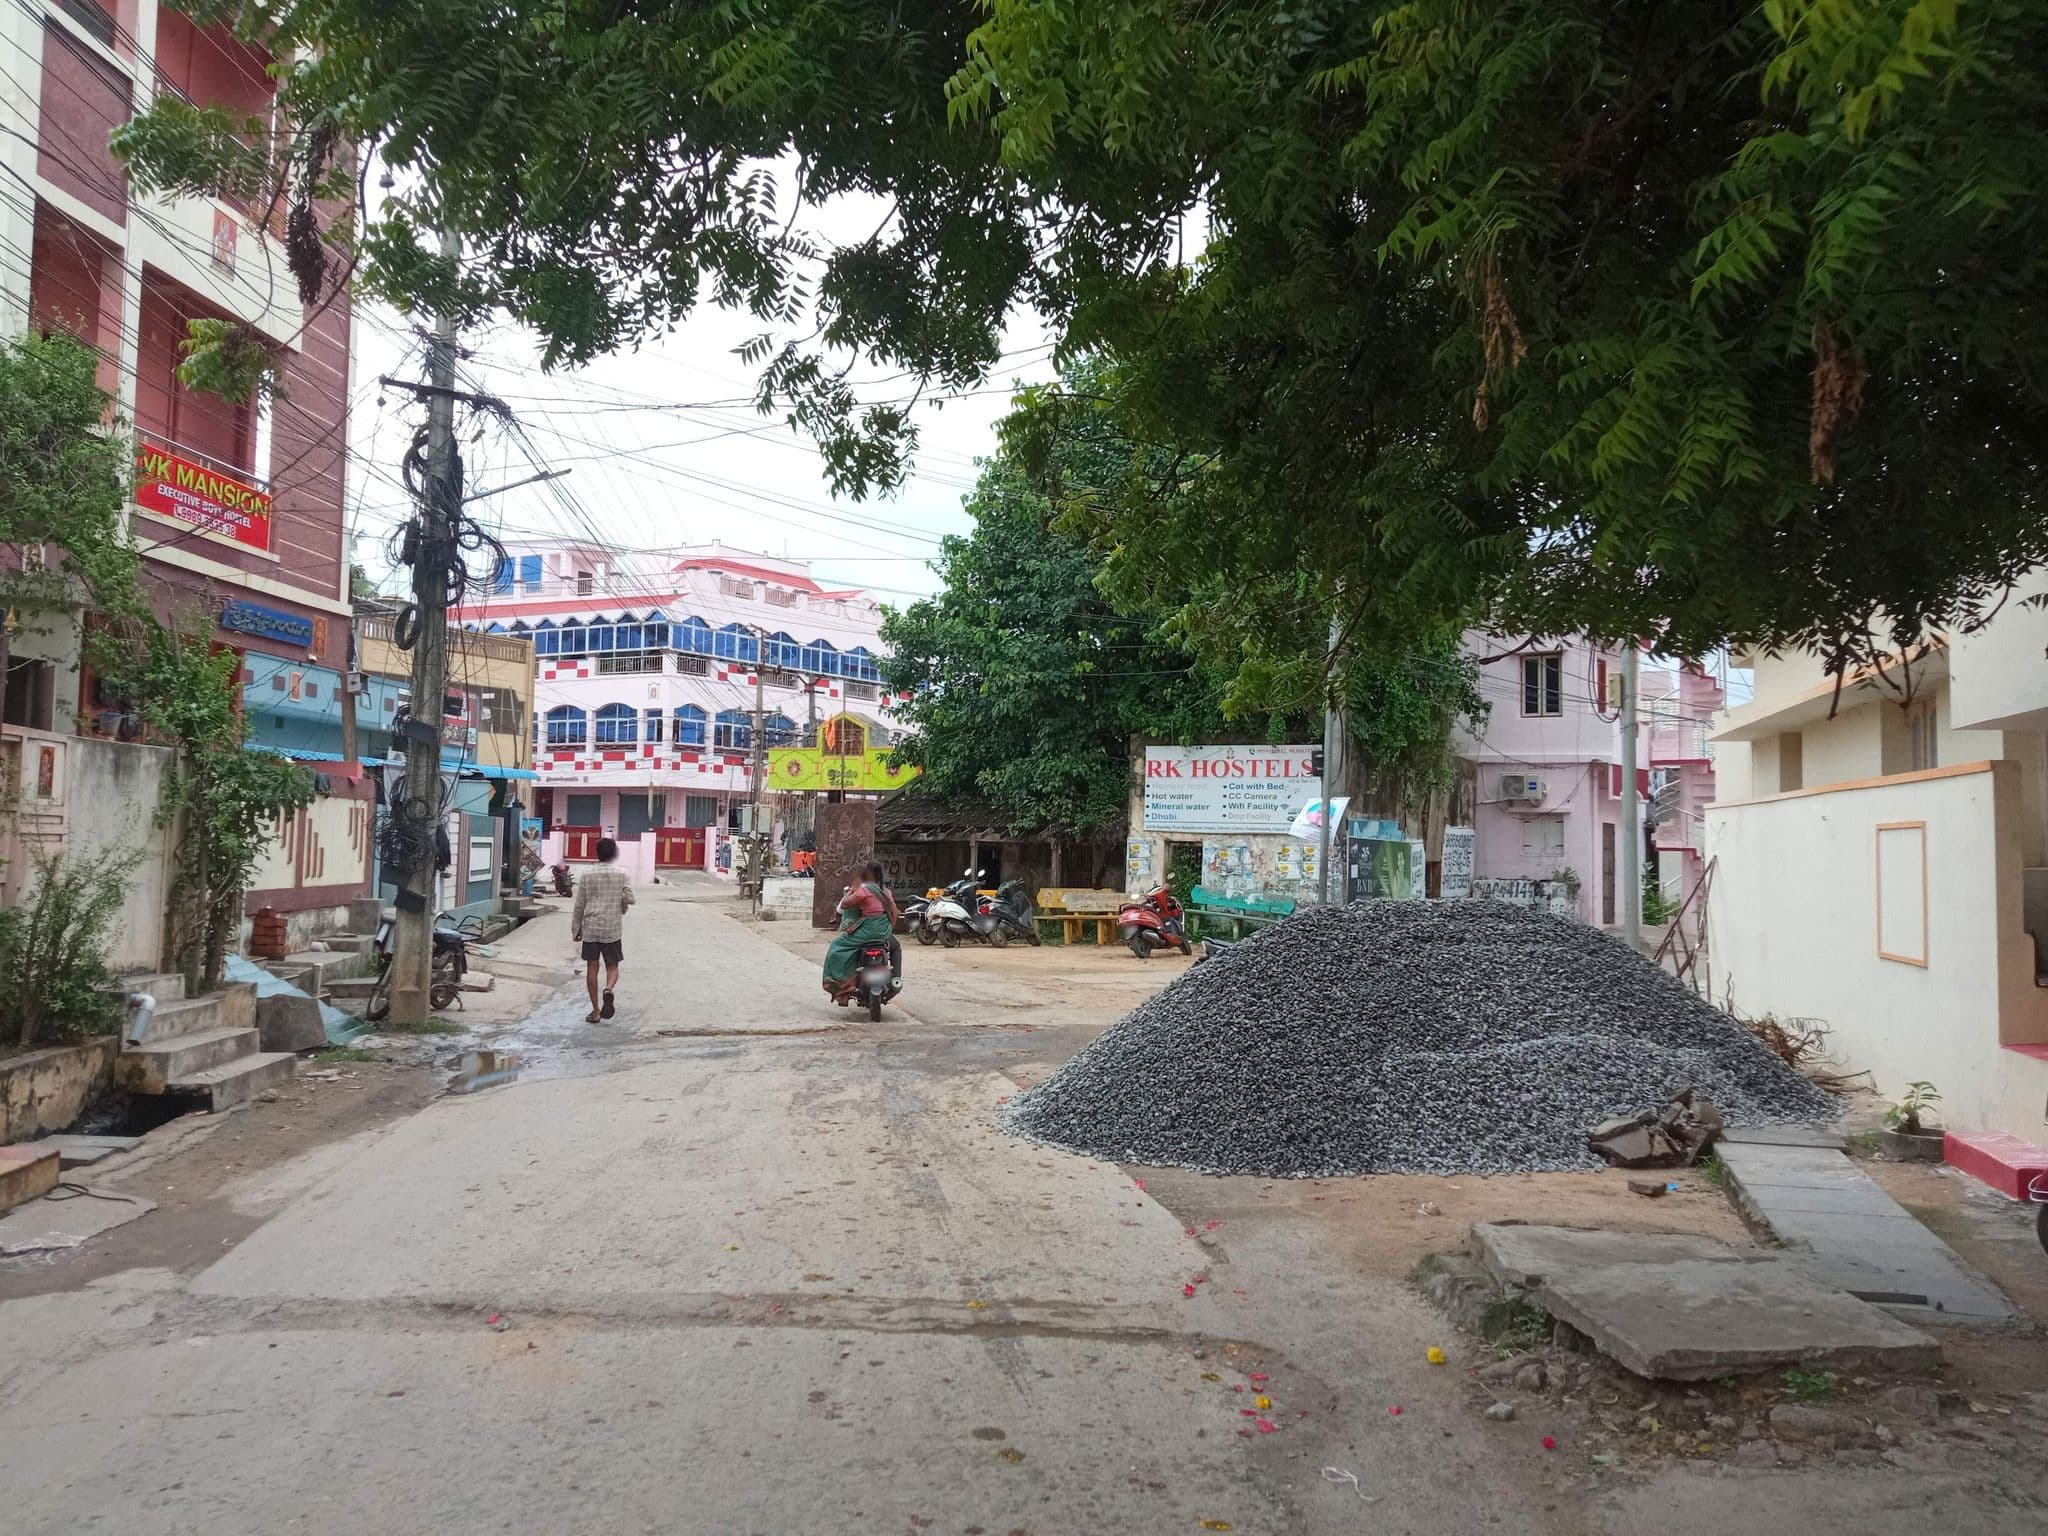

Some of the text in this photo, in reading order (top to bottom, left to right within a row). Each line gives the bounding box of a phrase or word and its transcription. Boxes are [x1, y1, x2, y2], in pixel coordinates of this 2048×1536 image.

[175, 463, 268, 521] MANSION
[158, 484, 201, 509] EXECUTIVE
[224, 510, 251, 528] HOSTEL
[1147, 759, 1314, 778] RK HOSTELS
[1228, 782, 1244, 790] Cot
[1267, 782, 1285, 790] Bed
[1228, 792, 1278, 800] CC Camera
[1151, 803, 1210, 811] Mineral water
[1228, 802, 1279, 811] Wifi Facility
[1228, 812, 1272, 821] Drop Facility
